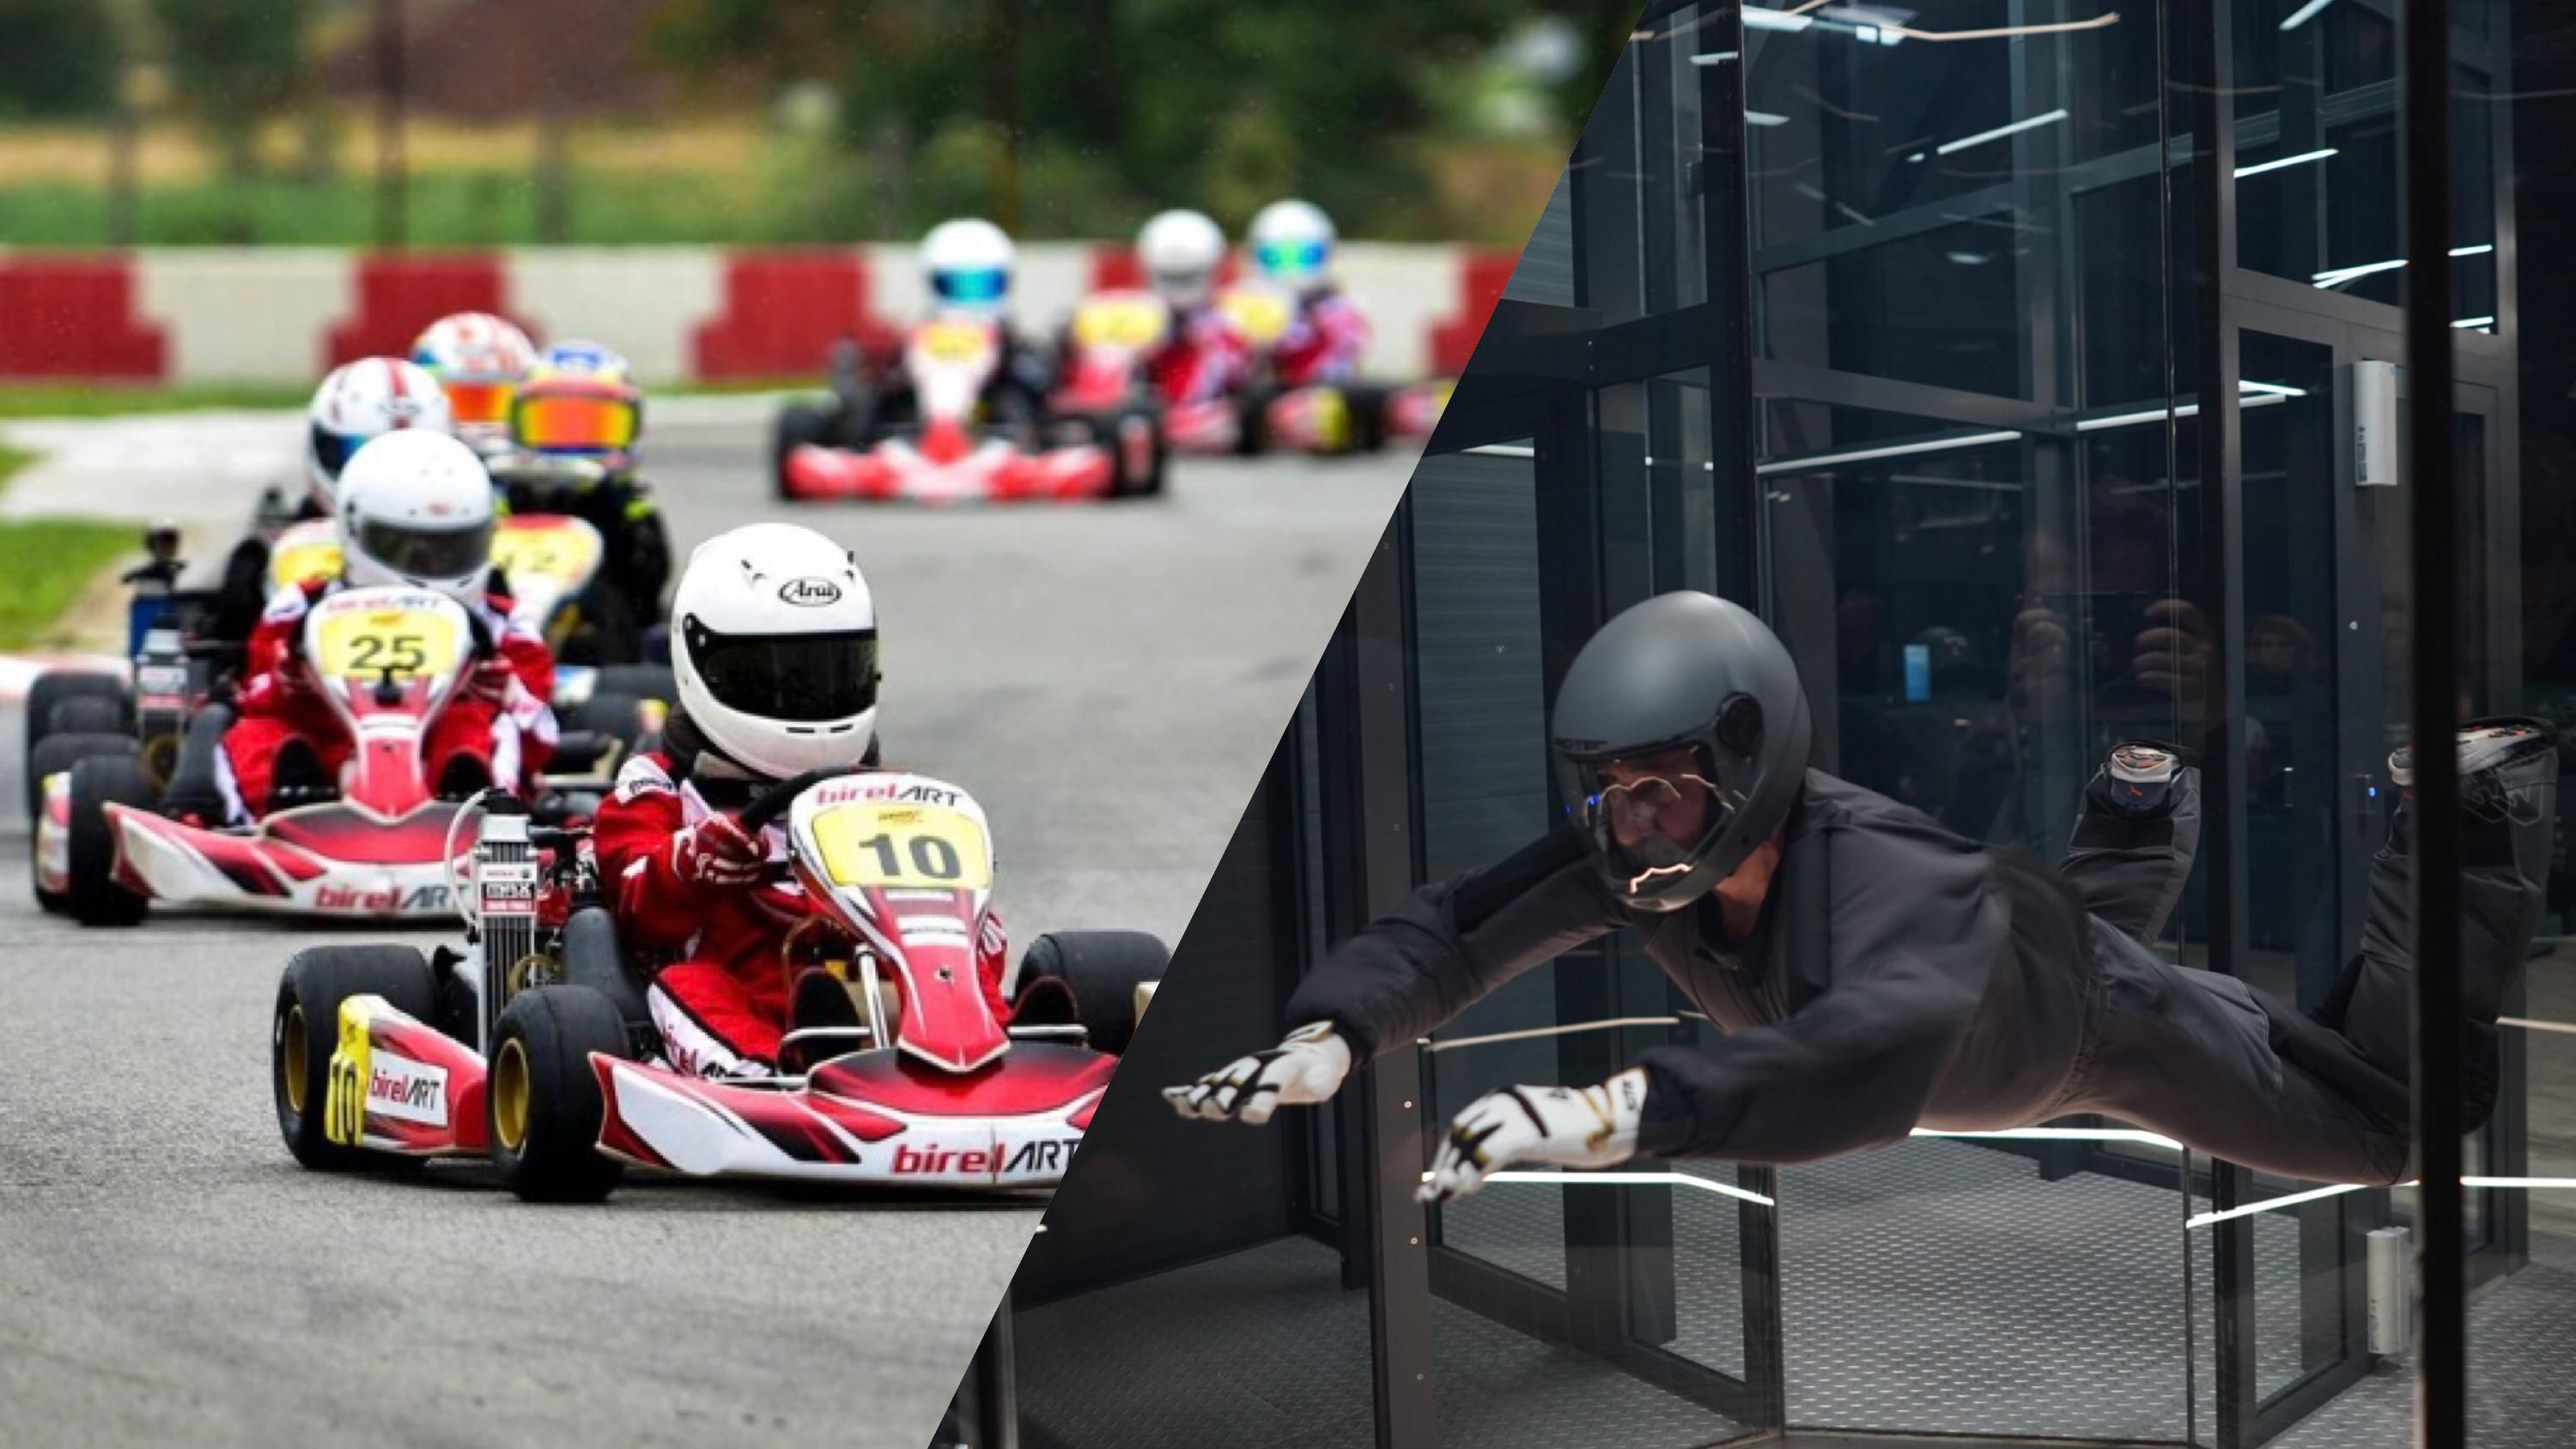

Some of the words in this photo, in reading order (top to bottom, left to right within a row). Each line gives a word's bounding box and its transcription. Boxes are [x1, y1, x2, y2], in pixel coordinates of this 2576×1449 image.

[789, 579, 834, 597] Arai
[349, 634, 426, 673] 25
[816, 783, 962, 806] birelART
[859, 833, 962, 880] 10
[331, 1061, 357, 1144] 10
[370, 1067, 440, 1112] birelART
[893, 1137, 1082, 1174] birelART
